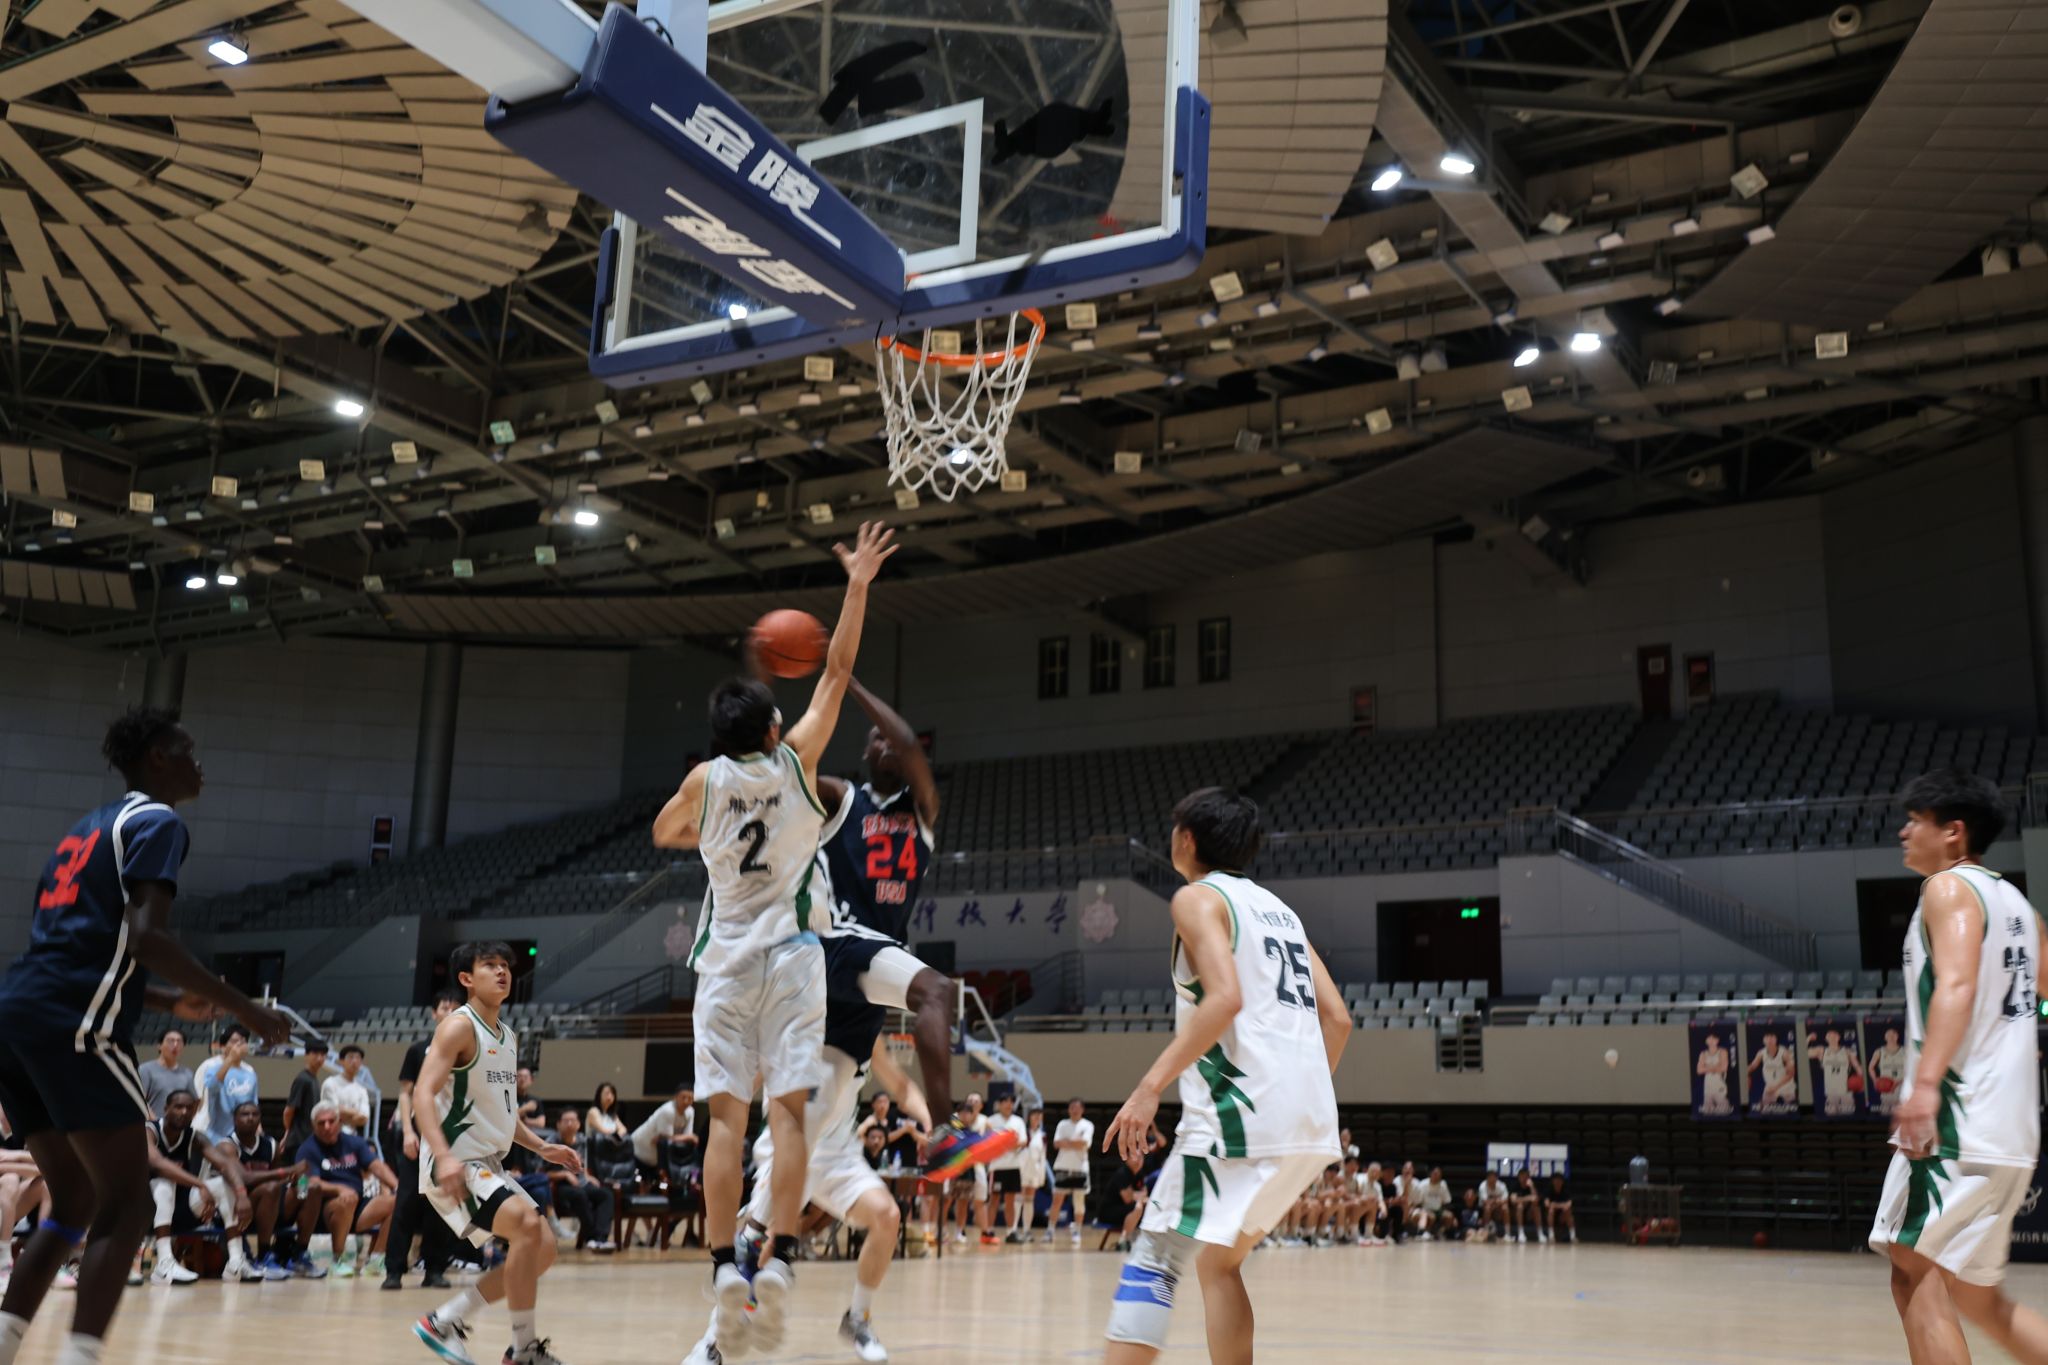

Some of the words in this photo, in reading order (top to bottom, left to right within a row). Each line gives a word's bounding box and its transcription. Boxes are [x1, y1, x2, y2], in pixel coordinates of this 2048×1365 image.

[655, 103, 834, 242] 金陵
[738, 820, 771, 876] 2
[866, 833, 917, 881] 24
[1264, 935, 1317, 1015] 25
